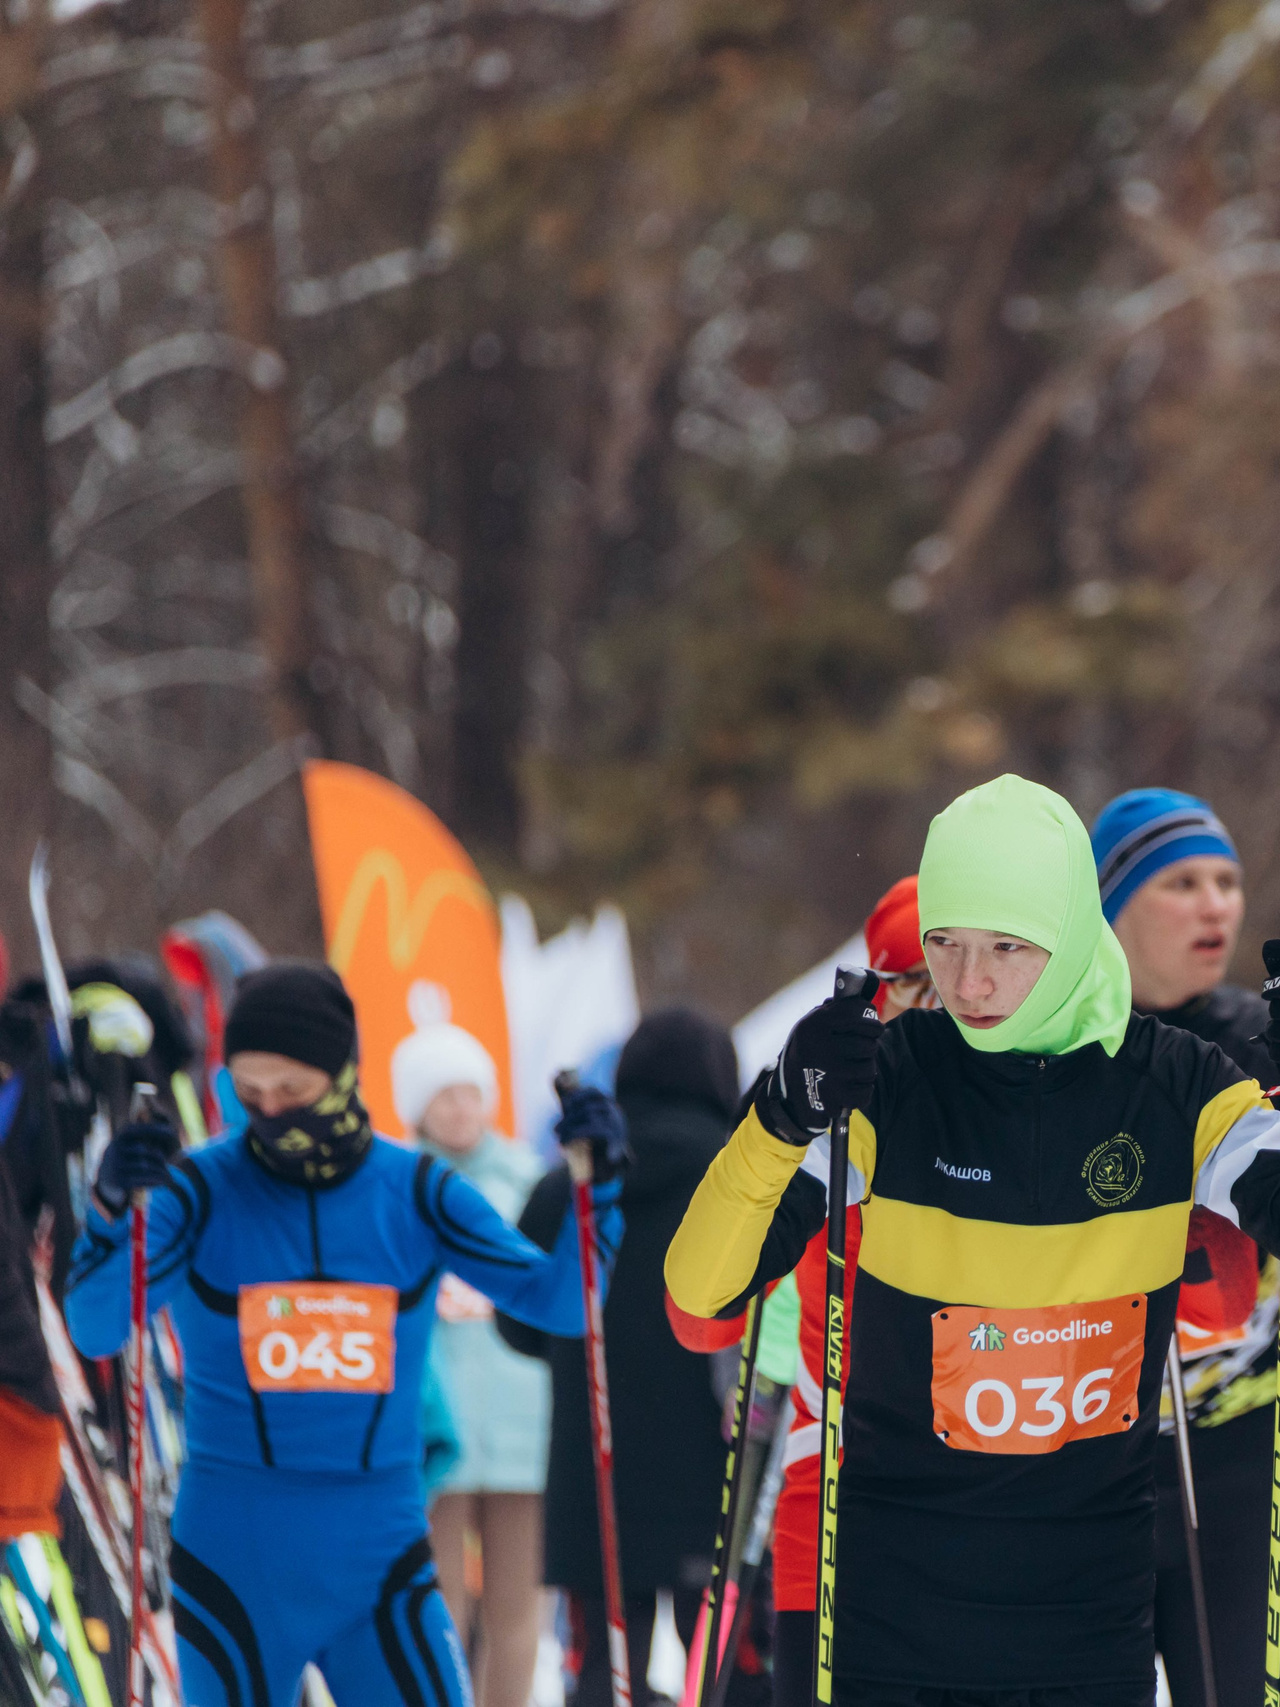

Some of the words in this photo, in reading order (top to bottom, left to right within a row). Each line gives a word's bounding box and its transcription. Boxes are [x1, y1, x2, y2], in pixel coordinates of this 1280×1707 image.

[258, 1330, 376, 1380] 045
[1013, 1319, 1113, 1345] Goodline
[965, 1368, 1114, 1437] 036
